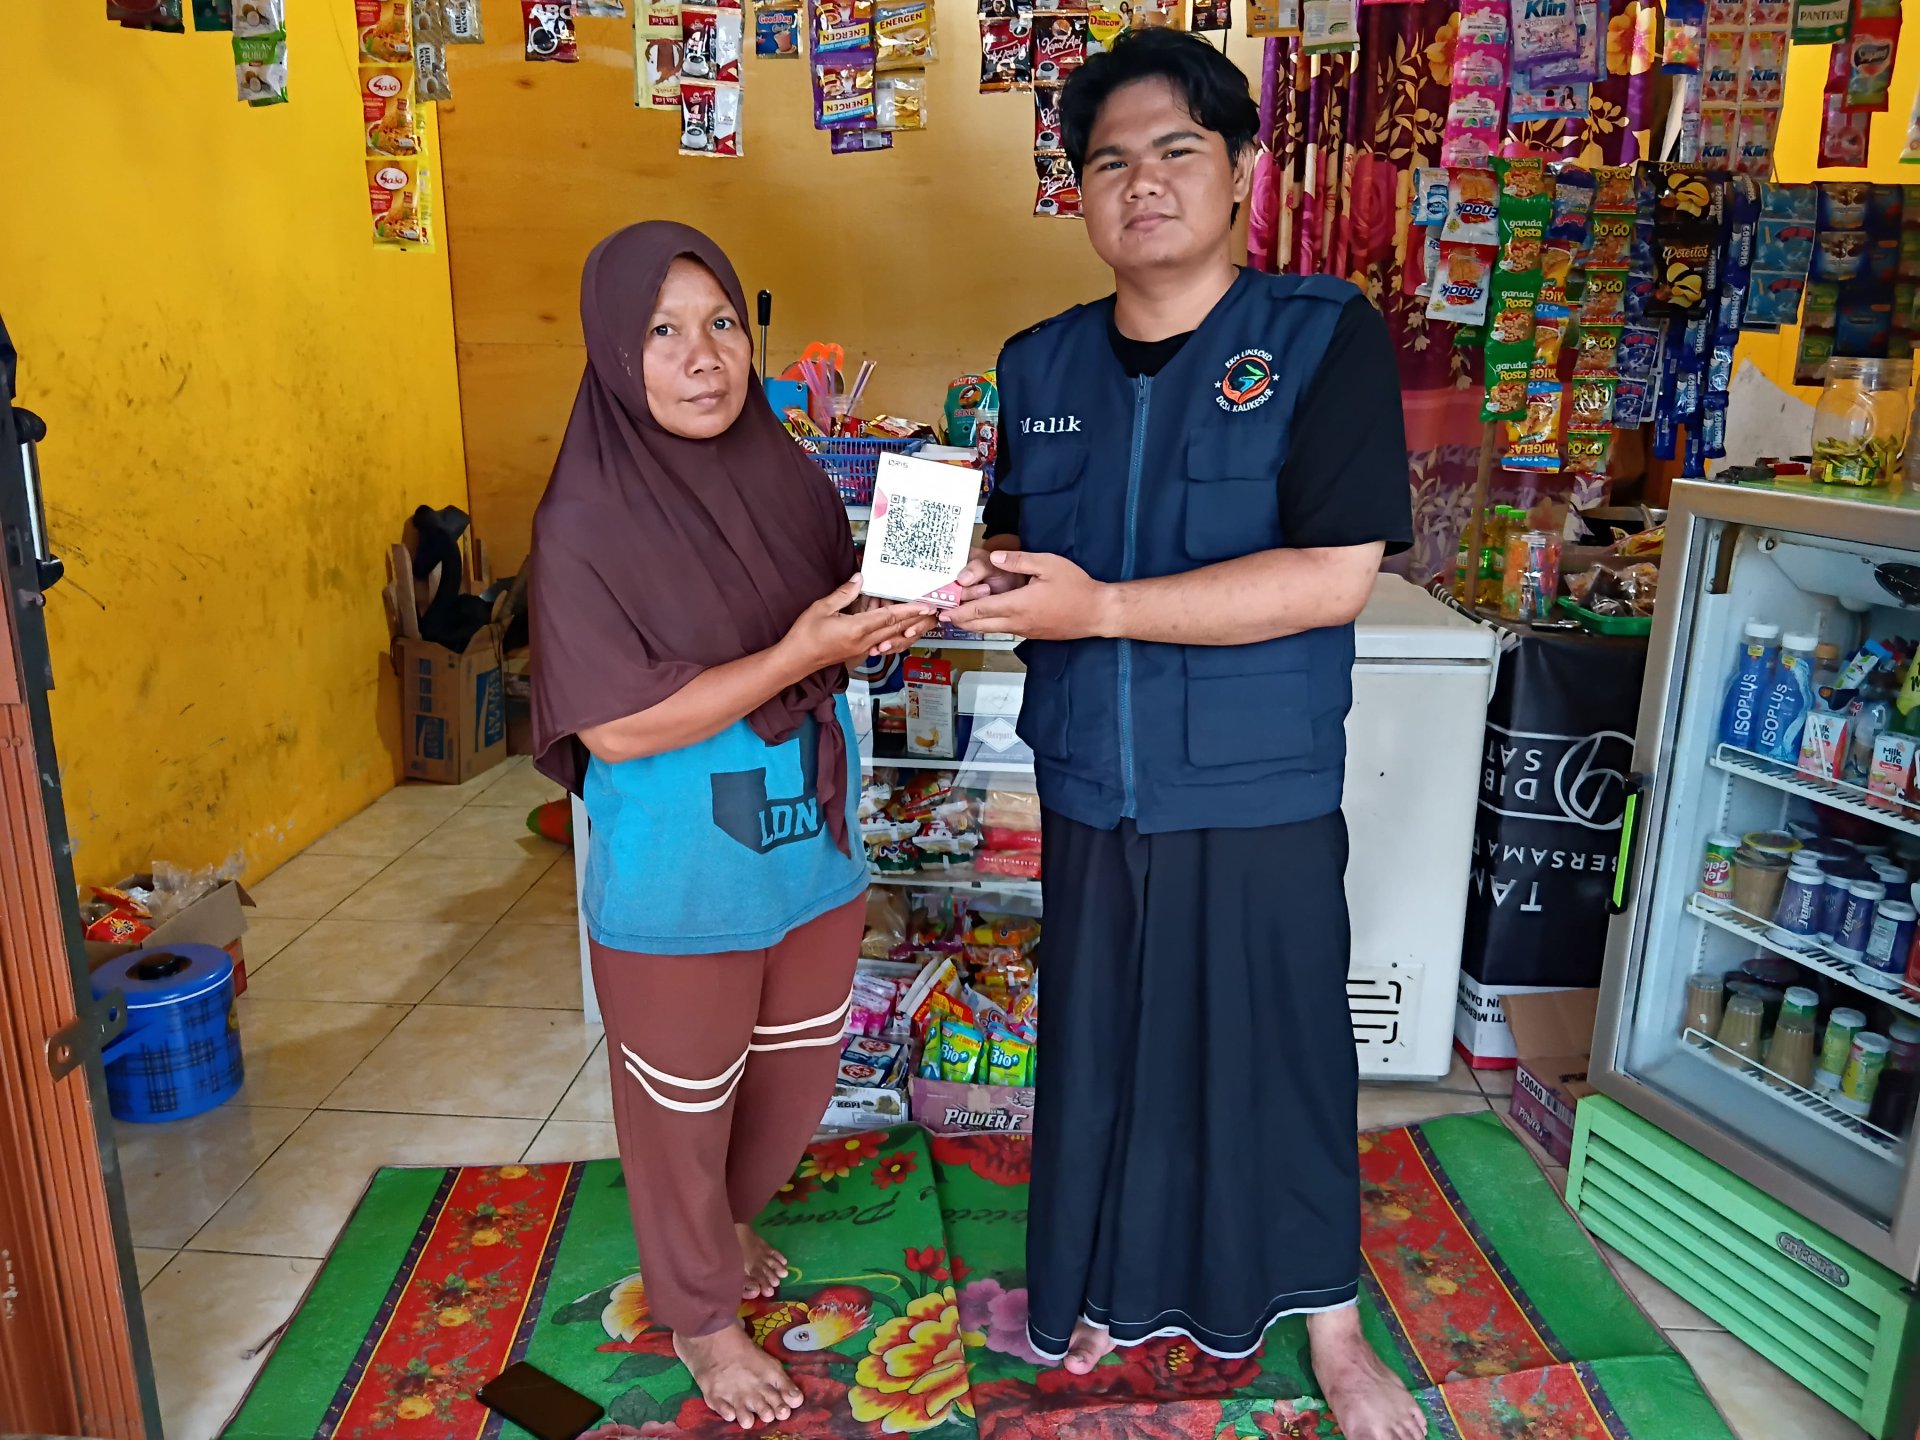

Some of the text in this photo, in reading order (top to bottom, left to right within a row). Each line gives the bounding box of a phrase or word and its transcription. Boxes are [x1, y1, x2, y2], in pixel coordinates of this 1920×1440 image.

[529, 4, 573, 19] ABC
[1800, 10, 1846, 21] PANTENE
[880, 12, 923, 30] ENERGEN
[1090, 15, 1120, 26] Dancow
[822, 28, 867, 42] ENERGEN
[1709, 68, 1736, 82] Klin
[1751, 69, 1779, 82] Klin
[373, 78, 397, 91] Sasa
[826, 98, 870, 112] ENERGEN
[1702, 145, 1728, 158] Klin
[1742, 145, 1769, 157] Klin
[380, 171, 403, 184] Sasa
[1455, 202, 1499, 219] Enaak
[1509, 219, 1542, 228] garuda
[1513, 227, 1542, 238] Rosta
[1593, 224, 1630, 237] PO-GO
[1440, 284, 1484, 300] Enaak
[1587, 280, 1623, 293] PO-GO
[1501, 290, 1535, 299] garuda
[1505, 298, 1534, 309] Rosta
[1581, 336, 1616, 349] PO-GO
[1224, 349, 1273, 369] KKN UNSOED
[1496, 361, 1528, 372] garuda
[1500, 370, 1528, 381] Rosta
[1232, 388, 1275, 412] KALIKESUR
[954, 409, 975, 417] BANG
[1567, 442, 1603, 455] PO-GO
[1733, 673, 1757, 736] ISOPLUS
[1761, 683, 1788, 747] ISOPLUS
[1486, 739, 1543, 771] SAT
[1882, 746, 1902, 757] Milk
[1884, 754, 1902, 765] Life
[1484, 767, 1538, 801] DIB
[758, 797, 818, 847] LDN
[1470, 867, 1543, 912] TAM
[1519, 1071, 1543, 1101] 50040
[943, 1108, 1006, 1129] POWER
